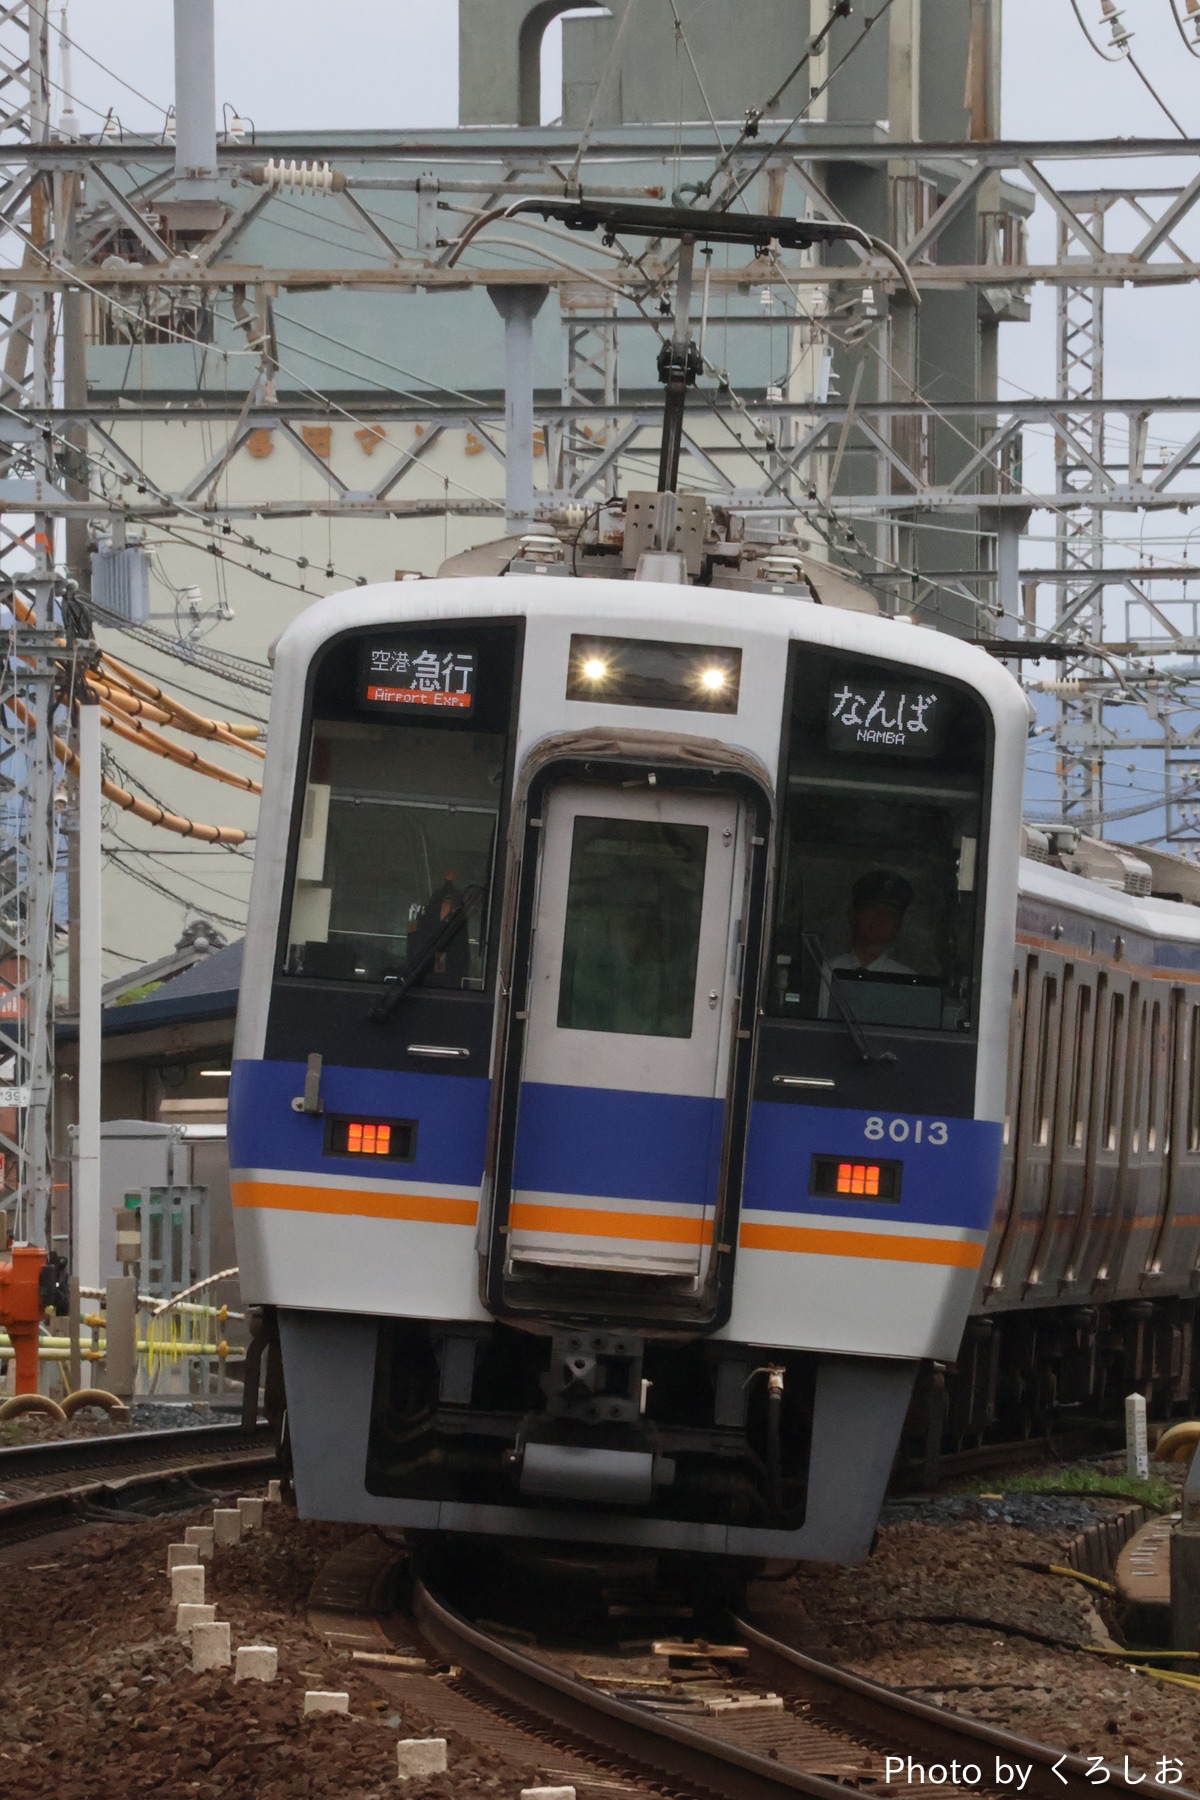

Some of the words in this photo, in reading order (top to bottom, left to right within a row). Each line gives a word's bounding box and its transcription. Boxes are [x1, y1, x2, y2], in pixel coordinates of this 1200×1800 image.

[370, 649, 474, 694] 空港急行
[374, 688, 428, 704] Airport
[433, 692, 465, 708] Exp.
[831, 685, 938, 733] なんば
[856, 729, 906, 746] NAMBA
[863, 1116, 949, 1146] 8013
